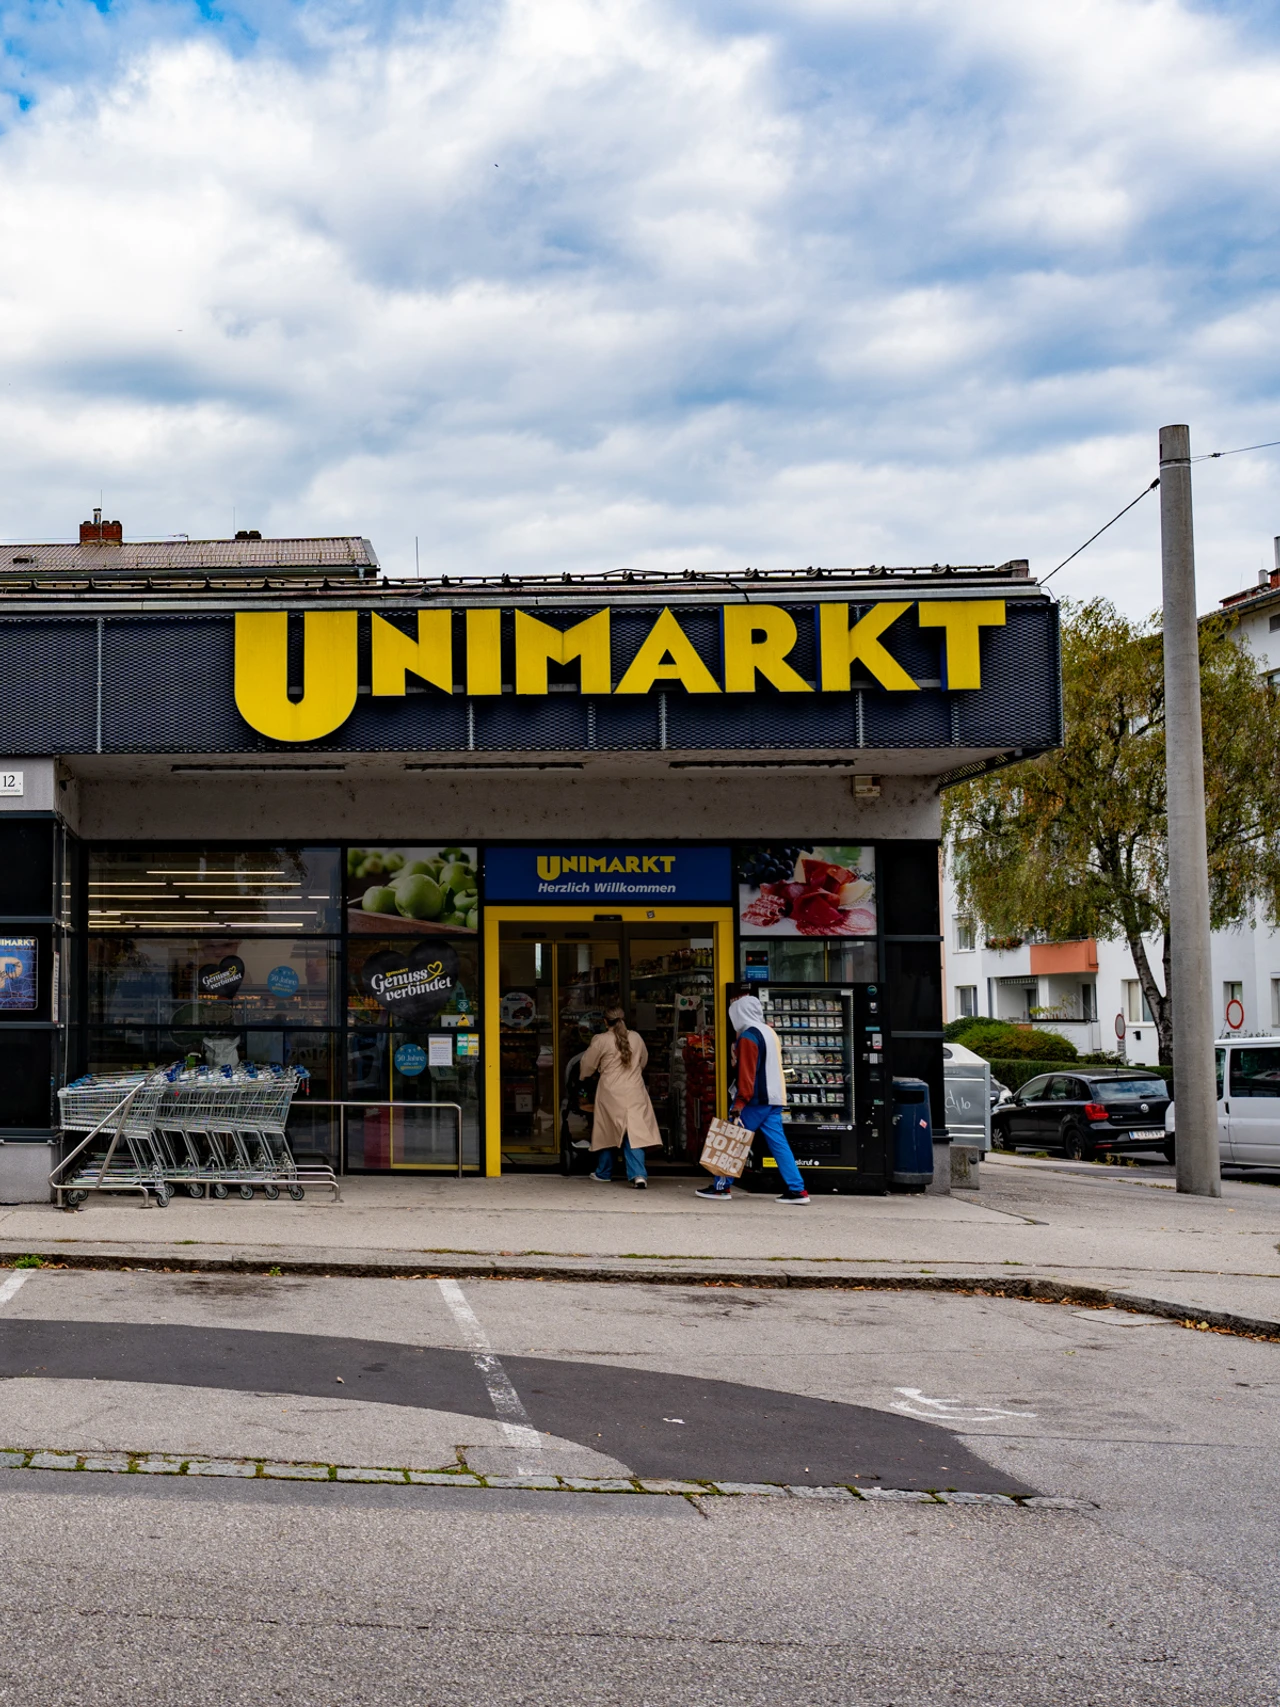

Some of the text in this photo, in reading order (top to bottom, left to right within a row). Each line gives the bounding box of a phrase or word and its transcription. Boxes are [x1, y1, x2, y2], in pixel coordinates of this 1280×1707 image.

[234, 599, 1006, 742] UNIMARKT
[3, 775, 15, 787] 12
[537, 856, 676, 881] UNIMARKT
[538, 882, 676, 893] Herzlich Willkommen
[202, 970, 231, 987] Genuss
[210, 973, 242, 989] verbindet
[371, 969, 428, 995] Genuss
[385, 976, 452, 1001] verbindet
